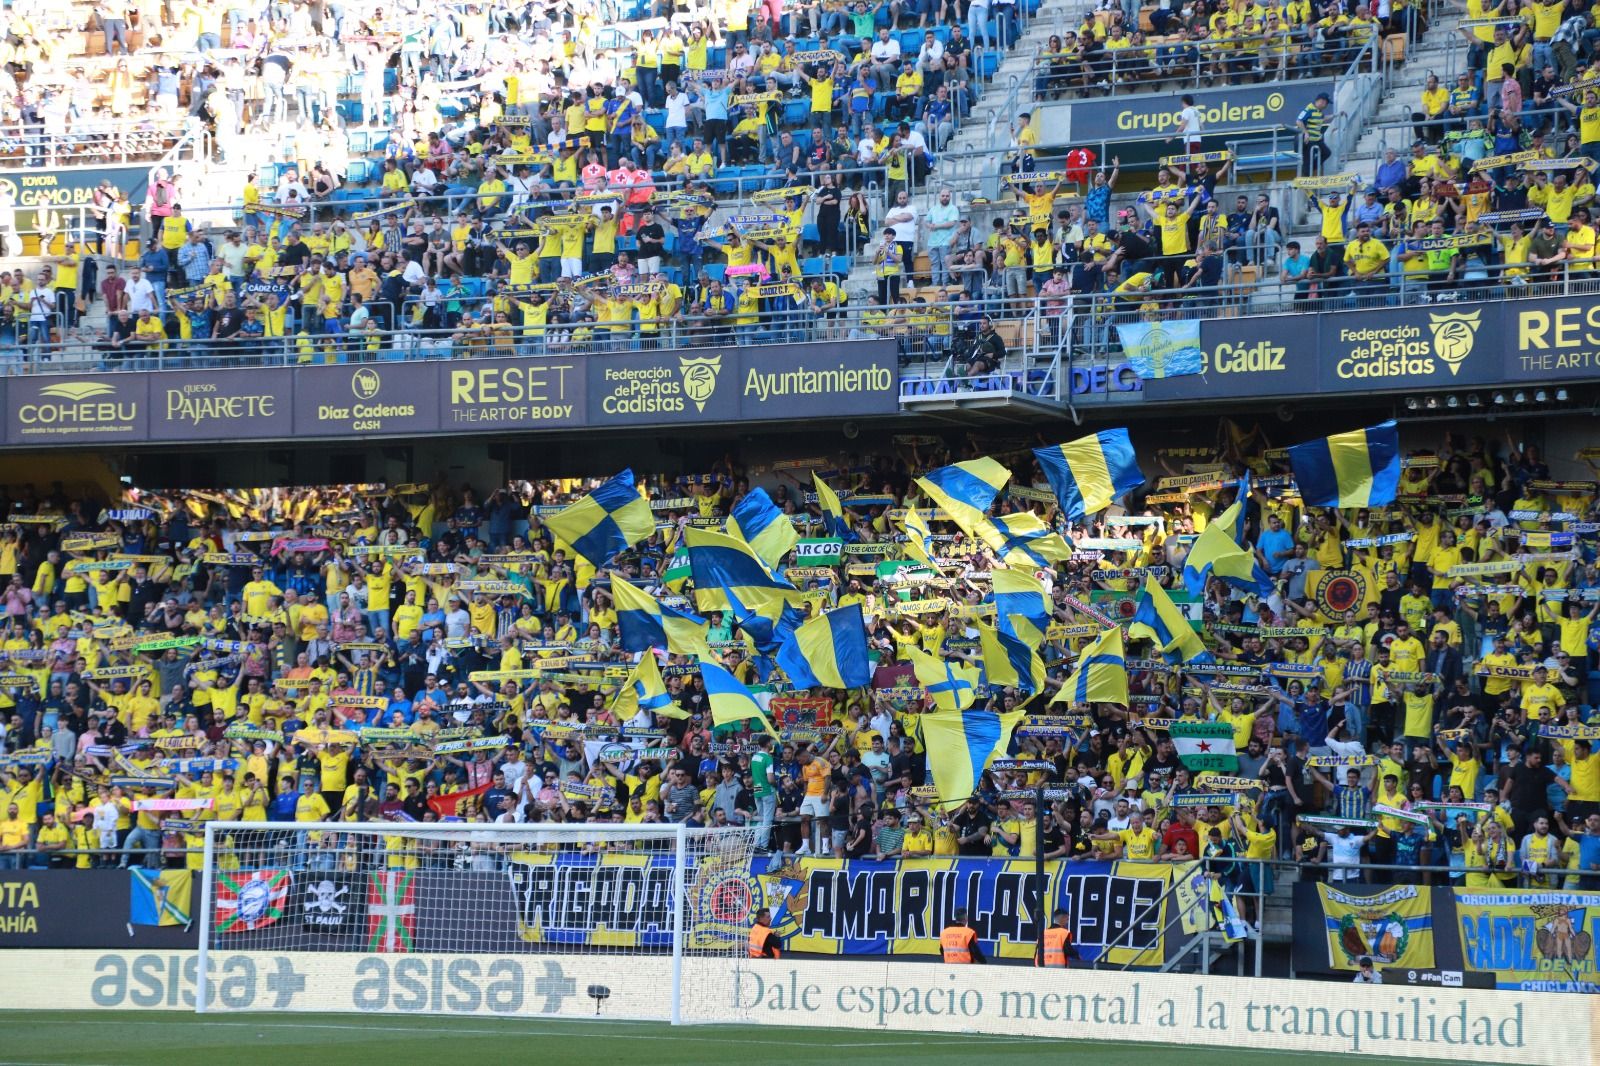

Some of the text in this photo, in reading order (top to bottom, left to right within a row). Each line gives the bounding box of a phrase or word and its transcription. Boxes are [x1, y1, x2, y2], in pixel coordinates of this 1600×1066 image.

[1117, 101, 1265, 133] Grupo Solera
[1078, 151, 1088, 165] 3
[21, 175, 58, 187] TOYOTA
[1422, 238, 1453, 249] CADIZ
[759, 286, 778, 296] CADIZ
[1340, 326, 1420, 342] Federación
[1519, 305, 1600, 350] RES
[1214, 341, 1285, 373] Cádiz
[1351, 338, 1430, 360] de Peñas
[1337, 355, 1435, 379] Cadistas
[1520, 352, 1592, 371] THE ART
[605, 367, 672, 381] Federación
[744, 363, 892, 401] Ayuntamiento
[1072, 366, 1107, 395] DE
[451, 365, 573, 404] RESET
[615, 378, 680, 396] de Peñas
[166, 390, 274, 425] PAJARETE
[319, 403, 415, 419] Díaz Cadenas
[603, 395, 684, 414] Cadistas
[19, 403, 136, 423] COHEBU
[452, 405, 573, 422] THE ART OF BODY
[353, 420, 380, 431] CASH
[1169, 474, 1214, 486] EXILIO CADISTA
[796, 543, 840, 555] ARCOS
[1066, 626, 1088, 634] CADIZ
[97, 666, 126, 676] CADIZ
[1496, 667, 1529, 678] CADIZ
[338, 697, 365, 705] CADIZ
[1549, 726, 1578, 738] CADIZ
[487, 737, 508, 745] PARTY
[1191, 758, 1225, 768] CADIZ
[1205, 776, 1235, 785] CADIZ
[0, 882, 39, 908] TA
[509, 863, 699, 933] BRIGADAS
[1462, 894, 1518, 905] ORGULLO
[1521, 893, 1579, 905] CADISTA
[801, 869, 1165, 949] AMARILLAS 1982
[316, 916, 343, 924] PAULI
[1462, 911, 1538, 971] CÁDIZ
[1541, 959, 1593, 973] DE MI
[92, 954, 257, 1008] asisa
[353, 956, 524, 1013] asisa
[732, 970, 1526, 1052] Dale espacio mental a la tranquilidad
